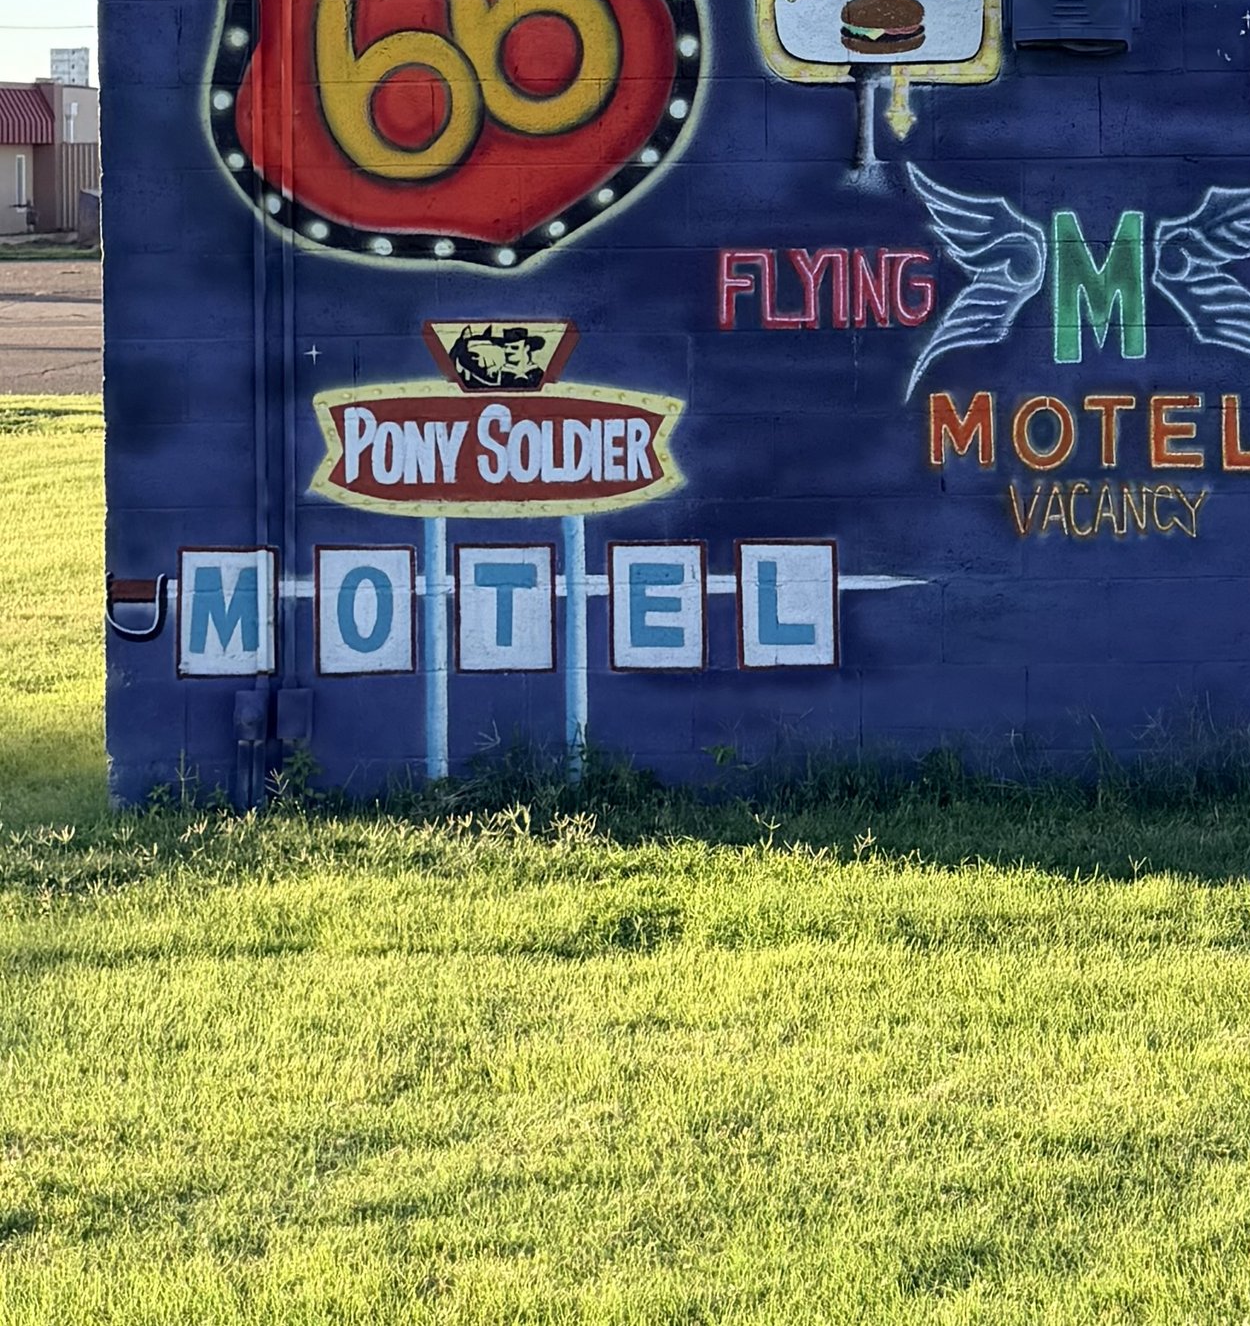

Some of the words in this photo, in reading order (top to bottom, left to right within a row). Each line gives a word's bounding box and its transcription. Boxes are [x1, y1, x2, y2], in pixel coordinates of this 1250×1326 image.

[718, 247, 937, 329] FLYING
[1052, 211, 1147, 364] M
[344, 405, 468, 485] PONY
[477, 403, 652, 484] SOLDIER
[1009, 482, 1207, 537] VACANCY
[188, 561, 816, 654] MOTEL
